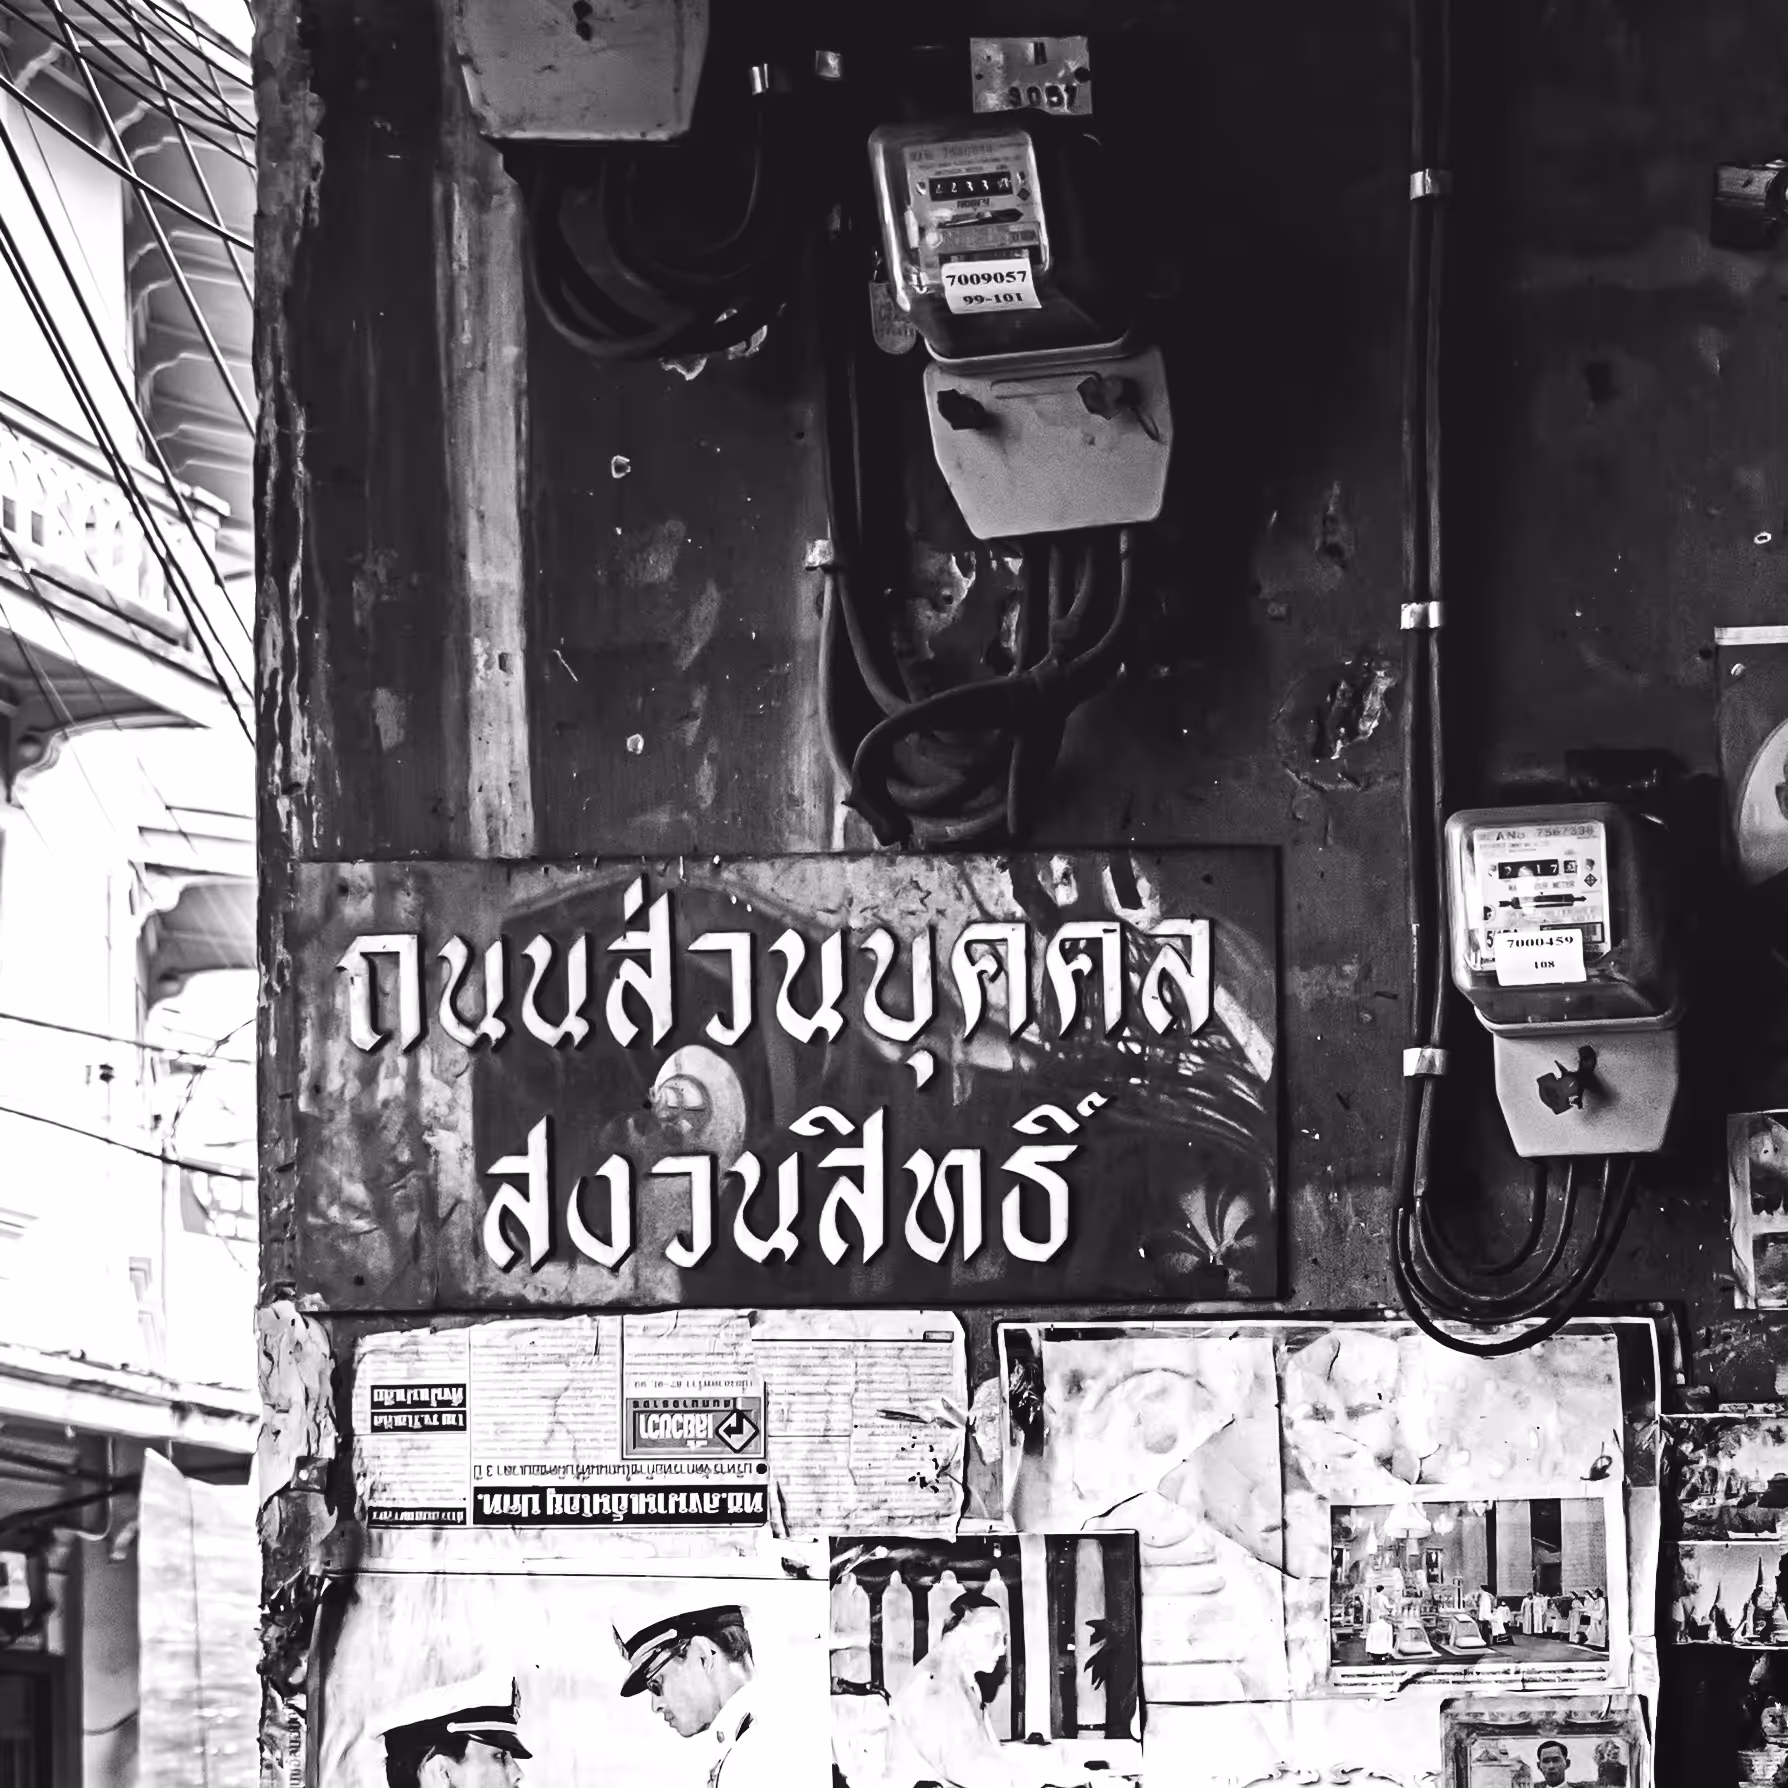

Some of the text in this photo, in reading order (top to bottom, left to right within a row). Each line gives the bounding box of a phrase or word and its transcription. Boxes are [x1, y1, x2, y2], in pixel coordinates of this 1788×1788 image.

[945, 270, 1028, 287] 7009057
[962, 292, 1023, 306] 99-101
[1506, 935, 1575, 950] 7000459
[1534, 960, 1556, 970] 108
[335, 873, 1215, 1092] ถนนส่วนบุคคล
[481, 1089, 1110, 1275] สงวนสิทธิ์
